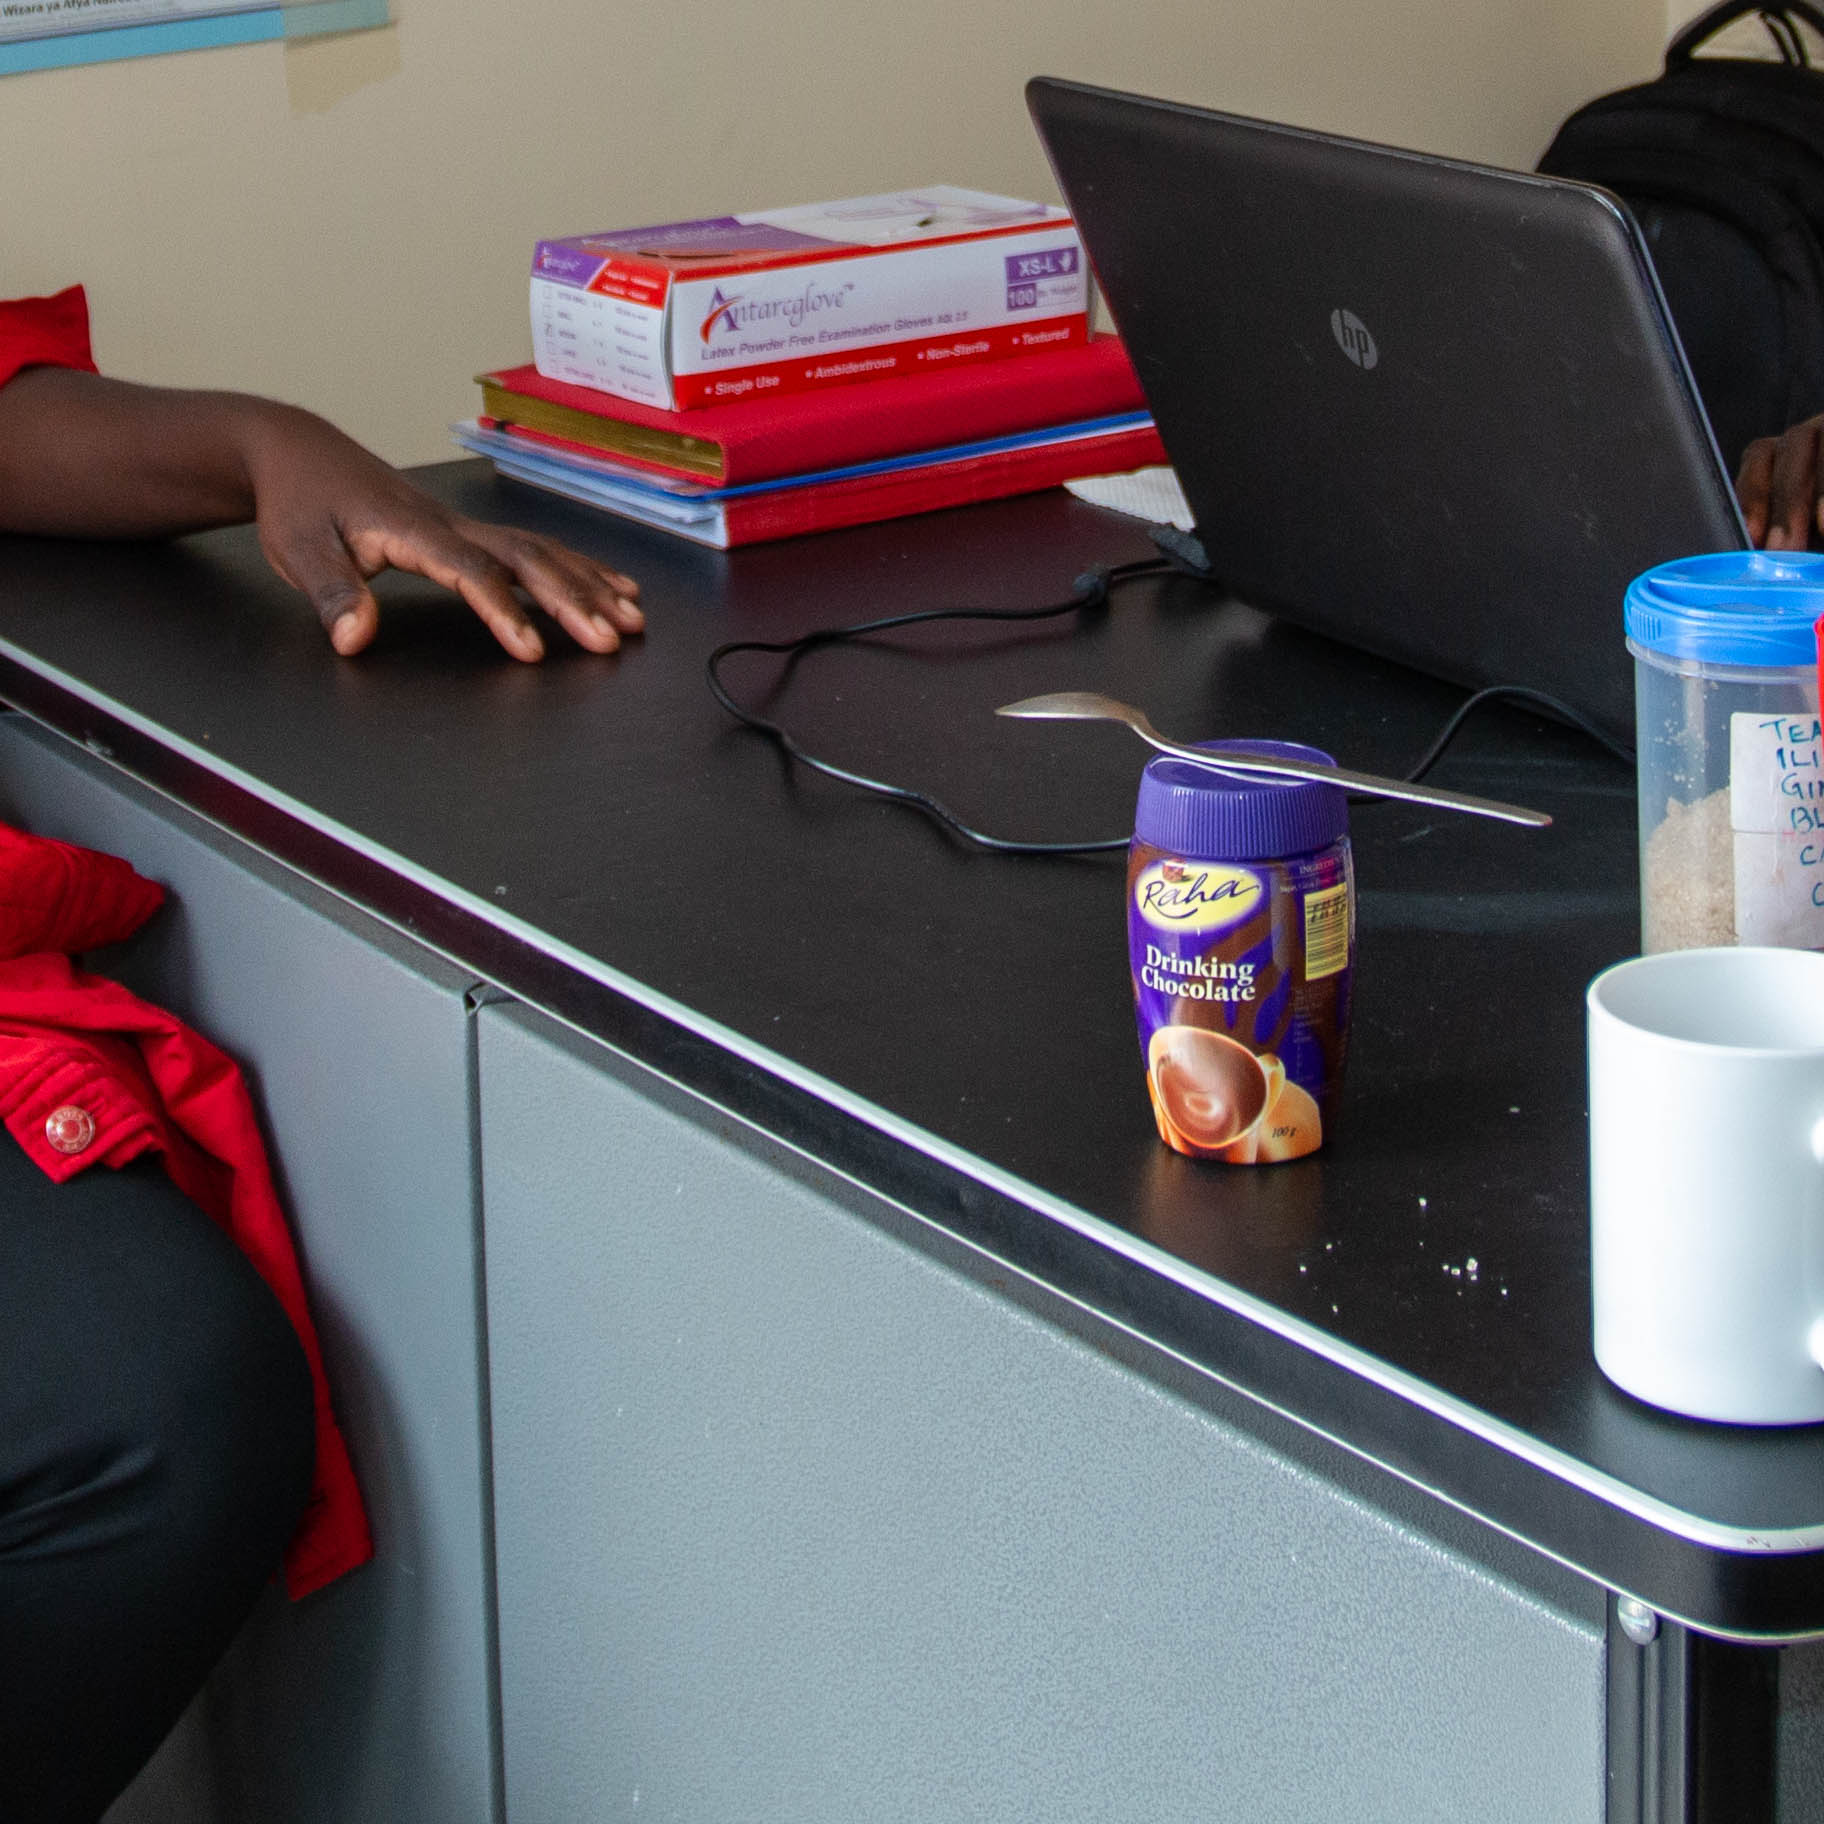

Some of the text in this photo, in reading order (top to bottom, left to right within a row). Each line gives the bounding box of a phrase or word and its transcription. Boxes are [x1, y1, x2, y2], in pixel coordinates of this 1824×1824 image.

[2, 1, 42, 17] Wizara
[47, 1, 60, 13] ya
[1019, 253, 1057, 277] XS-L
[1008, 288, 1035, 307] 100
[701, 344, 735, 361] Latex
[739, 337, 786, 355] Powder
[789, 333, 814, 347] Free
[819, 320, 889, 342] Examination
[894, 313, 932, 331] Gloves
[715, 326, 1070, 396] Single Use Ambidextrous Non-Sterile Textured
[1143, 872, 1260, 920] Raha
[1141, 965, 1256, 1002] Chocolate
[1146, 943, 1256, 987] Drinking
